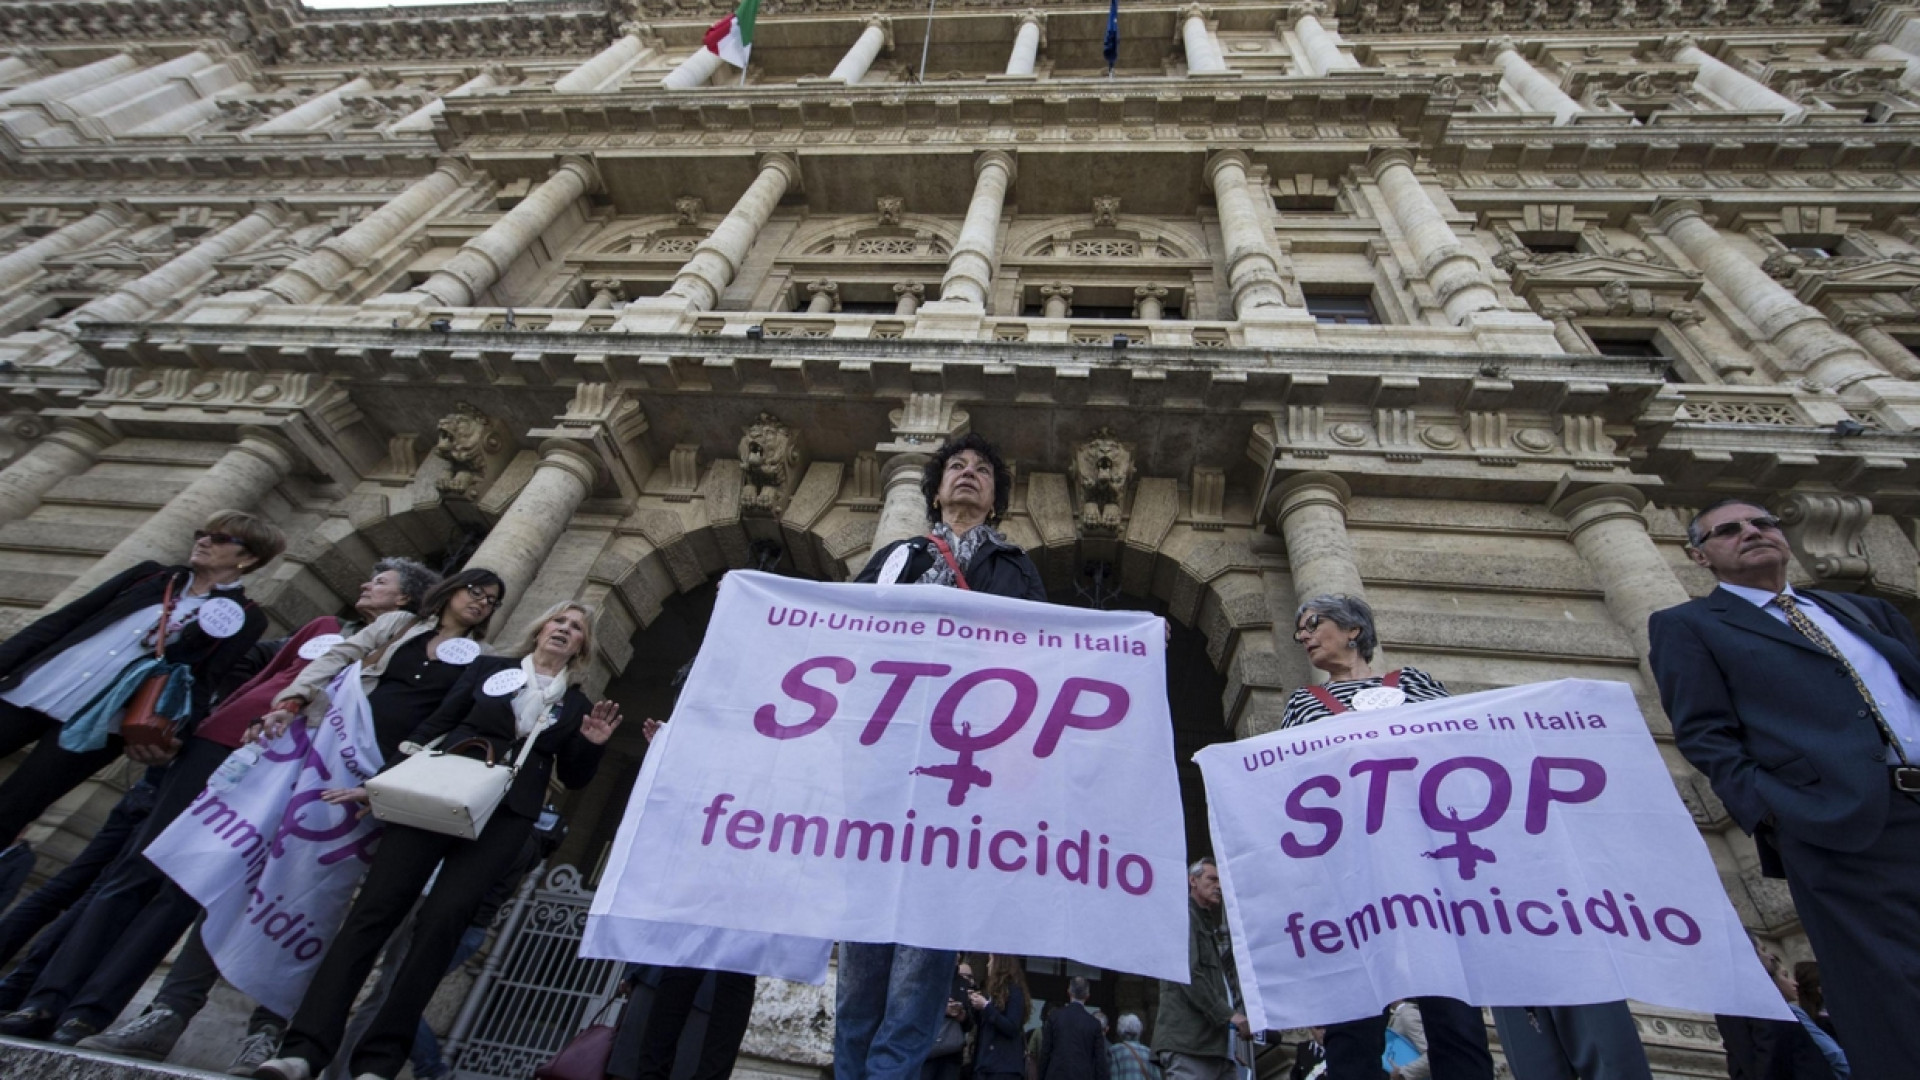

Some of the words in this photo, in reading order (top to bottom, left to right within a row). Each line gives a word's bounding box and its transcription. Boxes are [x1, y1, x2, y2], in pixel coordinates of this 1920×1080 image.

[937, 618, 1027, 645] Donne
[1038, 629, 1062, 648] in
[1074, 632, 1147, 657] Italia
[753, 655, 1131, 759] STOP
[1389, 718, 1479, 736] Donne
[1487, 713, 1516, 730] in
[1524, 711, 1607, 730] Italia
[701, 793, 1154, 897] femminicidio
[1280, 756, 1607, 859] STOP
[1286, 887, 1702, 958] femminicidio
